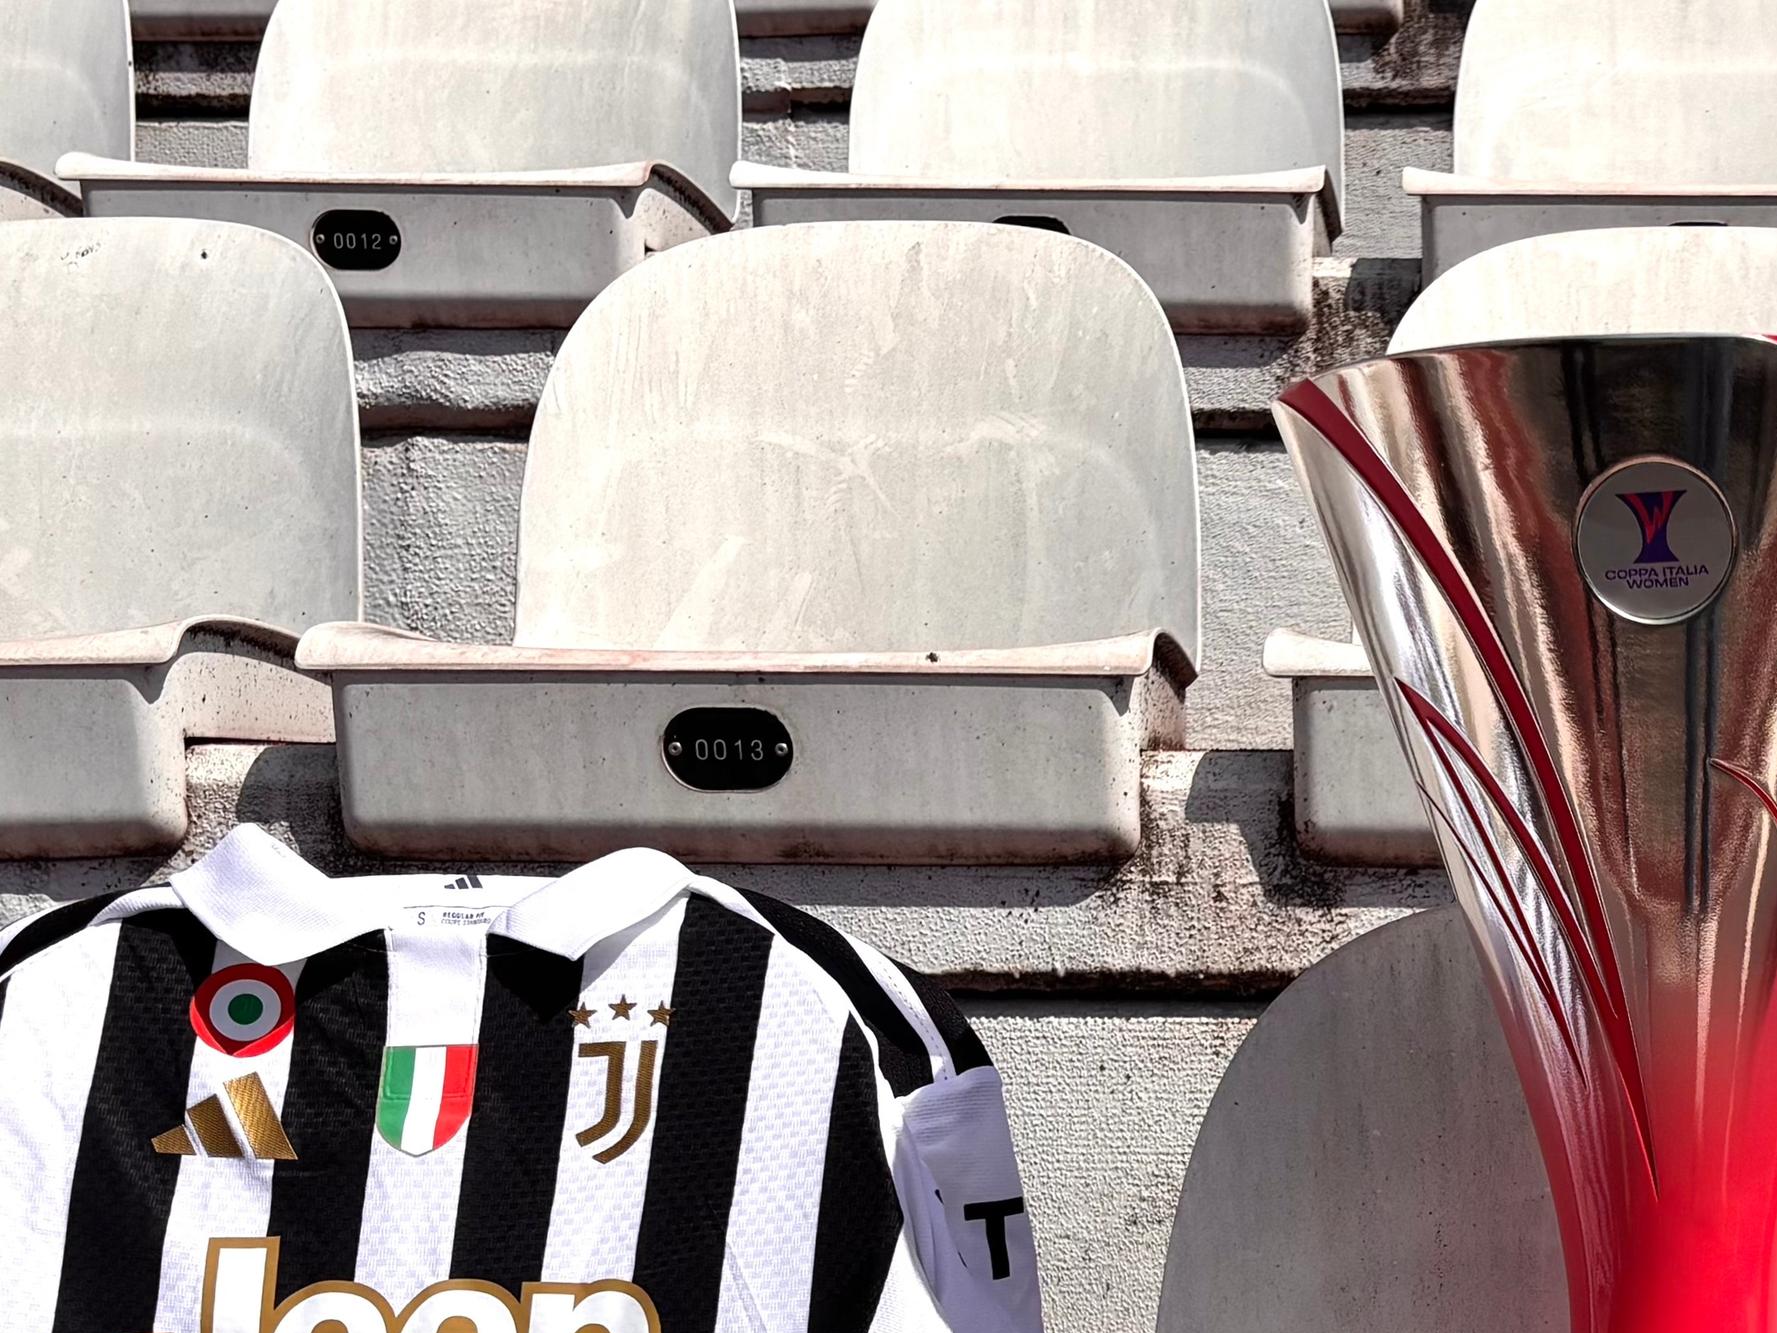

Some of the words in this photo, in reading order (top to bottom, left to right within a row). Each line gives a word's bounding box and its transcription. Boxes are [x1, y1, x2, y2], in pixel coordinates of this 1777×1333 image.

[333, 232, 382, 250] 0012
[1604, 567, 1659, 581] COPPA
[1662, 564, 1709, 577] ITALIA
[1626, 576, 1690, 590] WOMEN
[694, 738, 764, 761] 0013
